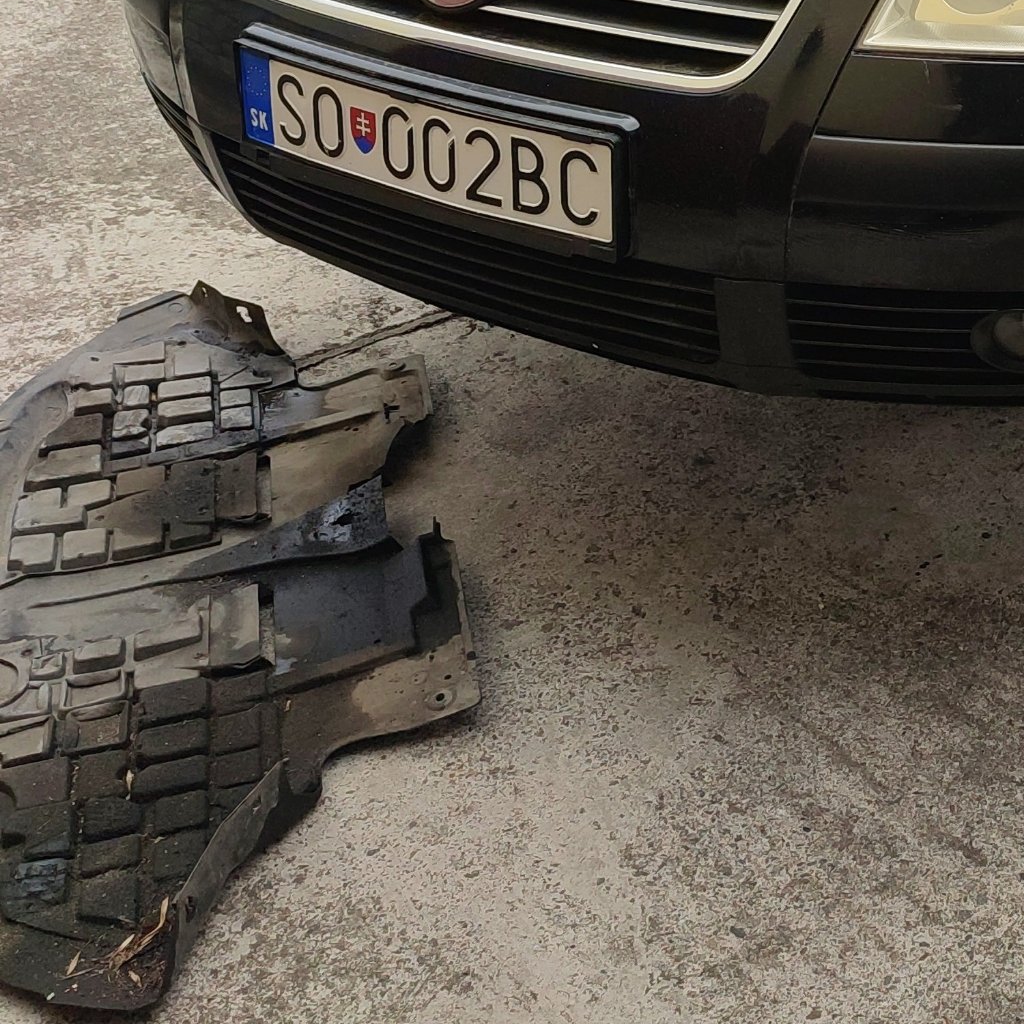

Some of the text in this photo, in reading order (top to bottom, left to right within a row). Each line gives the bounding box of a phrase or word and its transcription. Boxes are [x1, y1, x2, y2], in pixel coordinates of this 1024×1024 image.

[250, 107, 268, 131] SK
[277, 74, 599, 226] SO 002BC
